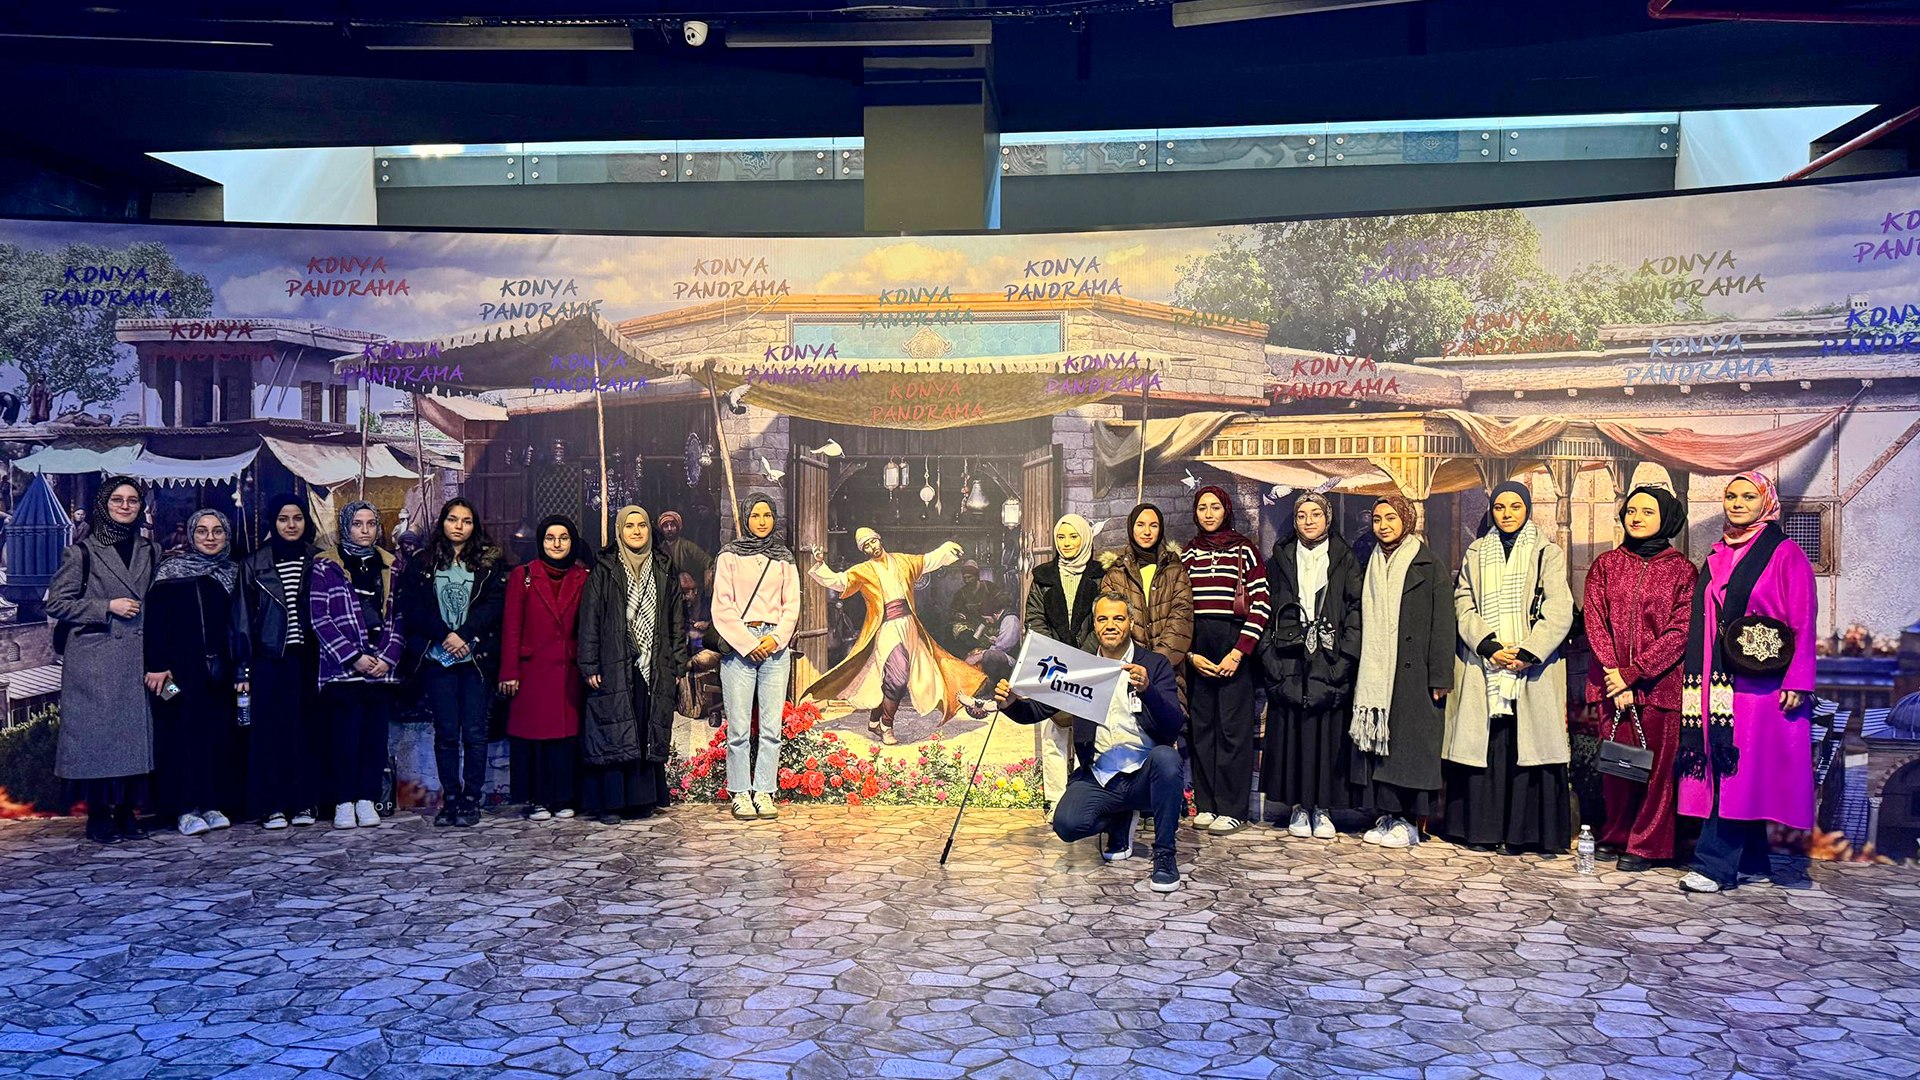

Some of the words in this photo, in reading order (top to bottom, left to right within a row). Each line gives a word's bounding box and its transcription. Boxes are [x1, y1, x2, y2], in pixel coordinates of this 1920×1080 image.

[307, 256, 388, 276] KONYA
[693, 256, 769, 277] KONYA
[1024, 256, 1101, 278] KONYA
[1639, 250, 1737, 277] KONYA
[63, 265, 150, 284] KONYA
[38, 288, 173, 308] PANORAMA
[286, 278, 410, 298] PANORAMA
[500, 278, 578, 298] KONYA
[673, 279, 790, 299] PANORAMA
[878, 286, 954, 307] KONYA
[1004, 277, 1123, 302] PANORAMA
[1615, 274, 1767, 301] PANORAMA
[479, 299, 603, 321] PANORAMA
[858, 308, 975, 330] PANORAMA
[1461, 307, 1550, 334] KONYA
[169, 321, 252, 341] KONYA
[764, 343, 838, 363] KONYA
[1440, 332, 1579, 359] PANORAMA
[1649, 333, 1745, 359] KONYA
[550, 352, 627, 371] KONYA
[1063, 351, 1141, 374] KONYA
[1291, 353, 1376, 378] KONYA
[1623, 356, 1775, 387] PANORAMA
[343, 364, 464, 385] PANORAMA
[744, 363, 860, 385] PANORAMA
[1045, 372, 1163, 395] PANORAMA
[532, 375, 650, 395] PANORAMA
[889, 380, 962, 400] KONYA
[1270, 376, 1400, 401] PANORAMA
[870, 402, 984, 423] PANORAMA
